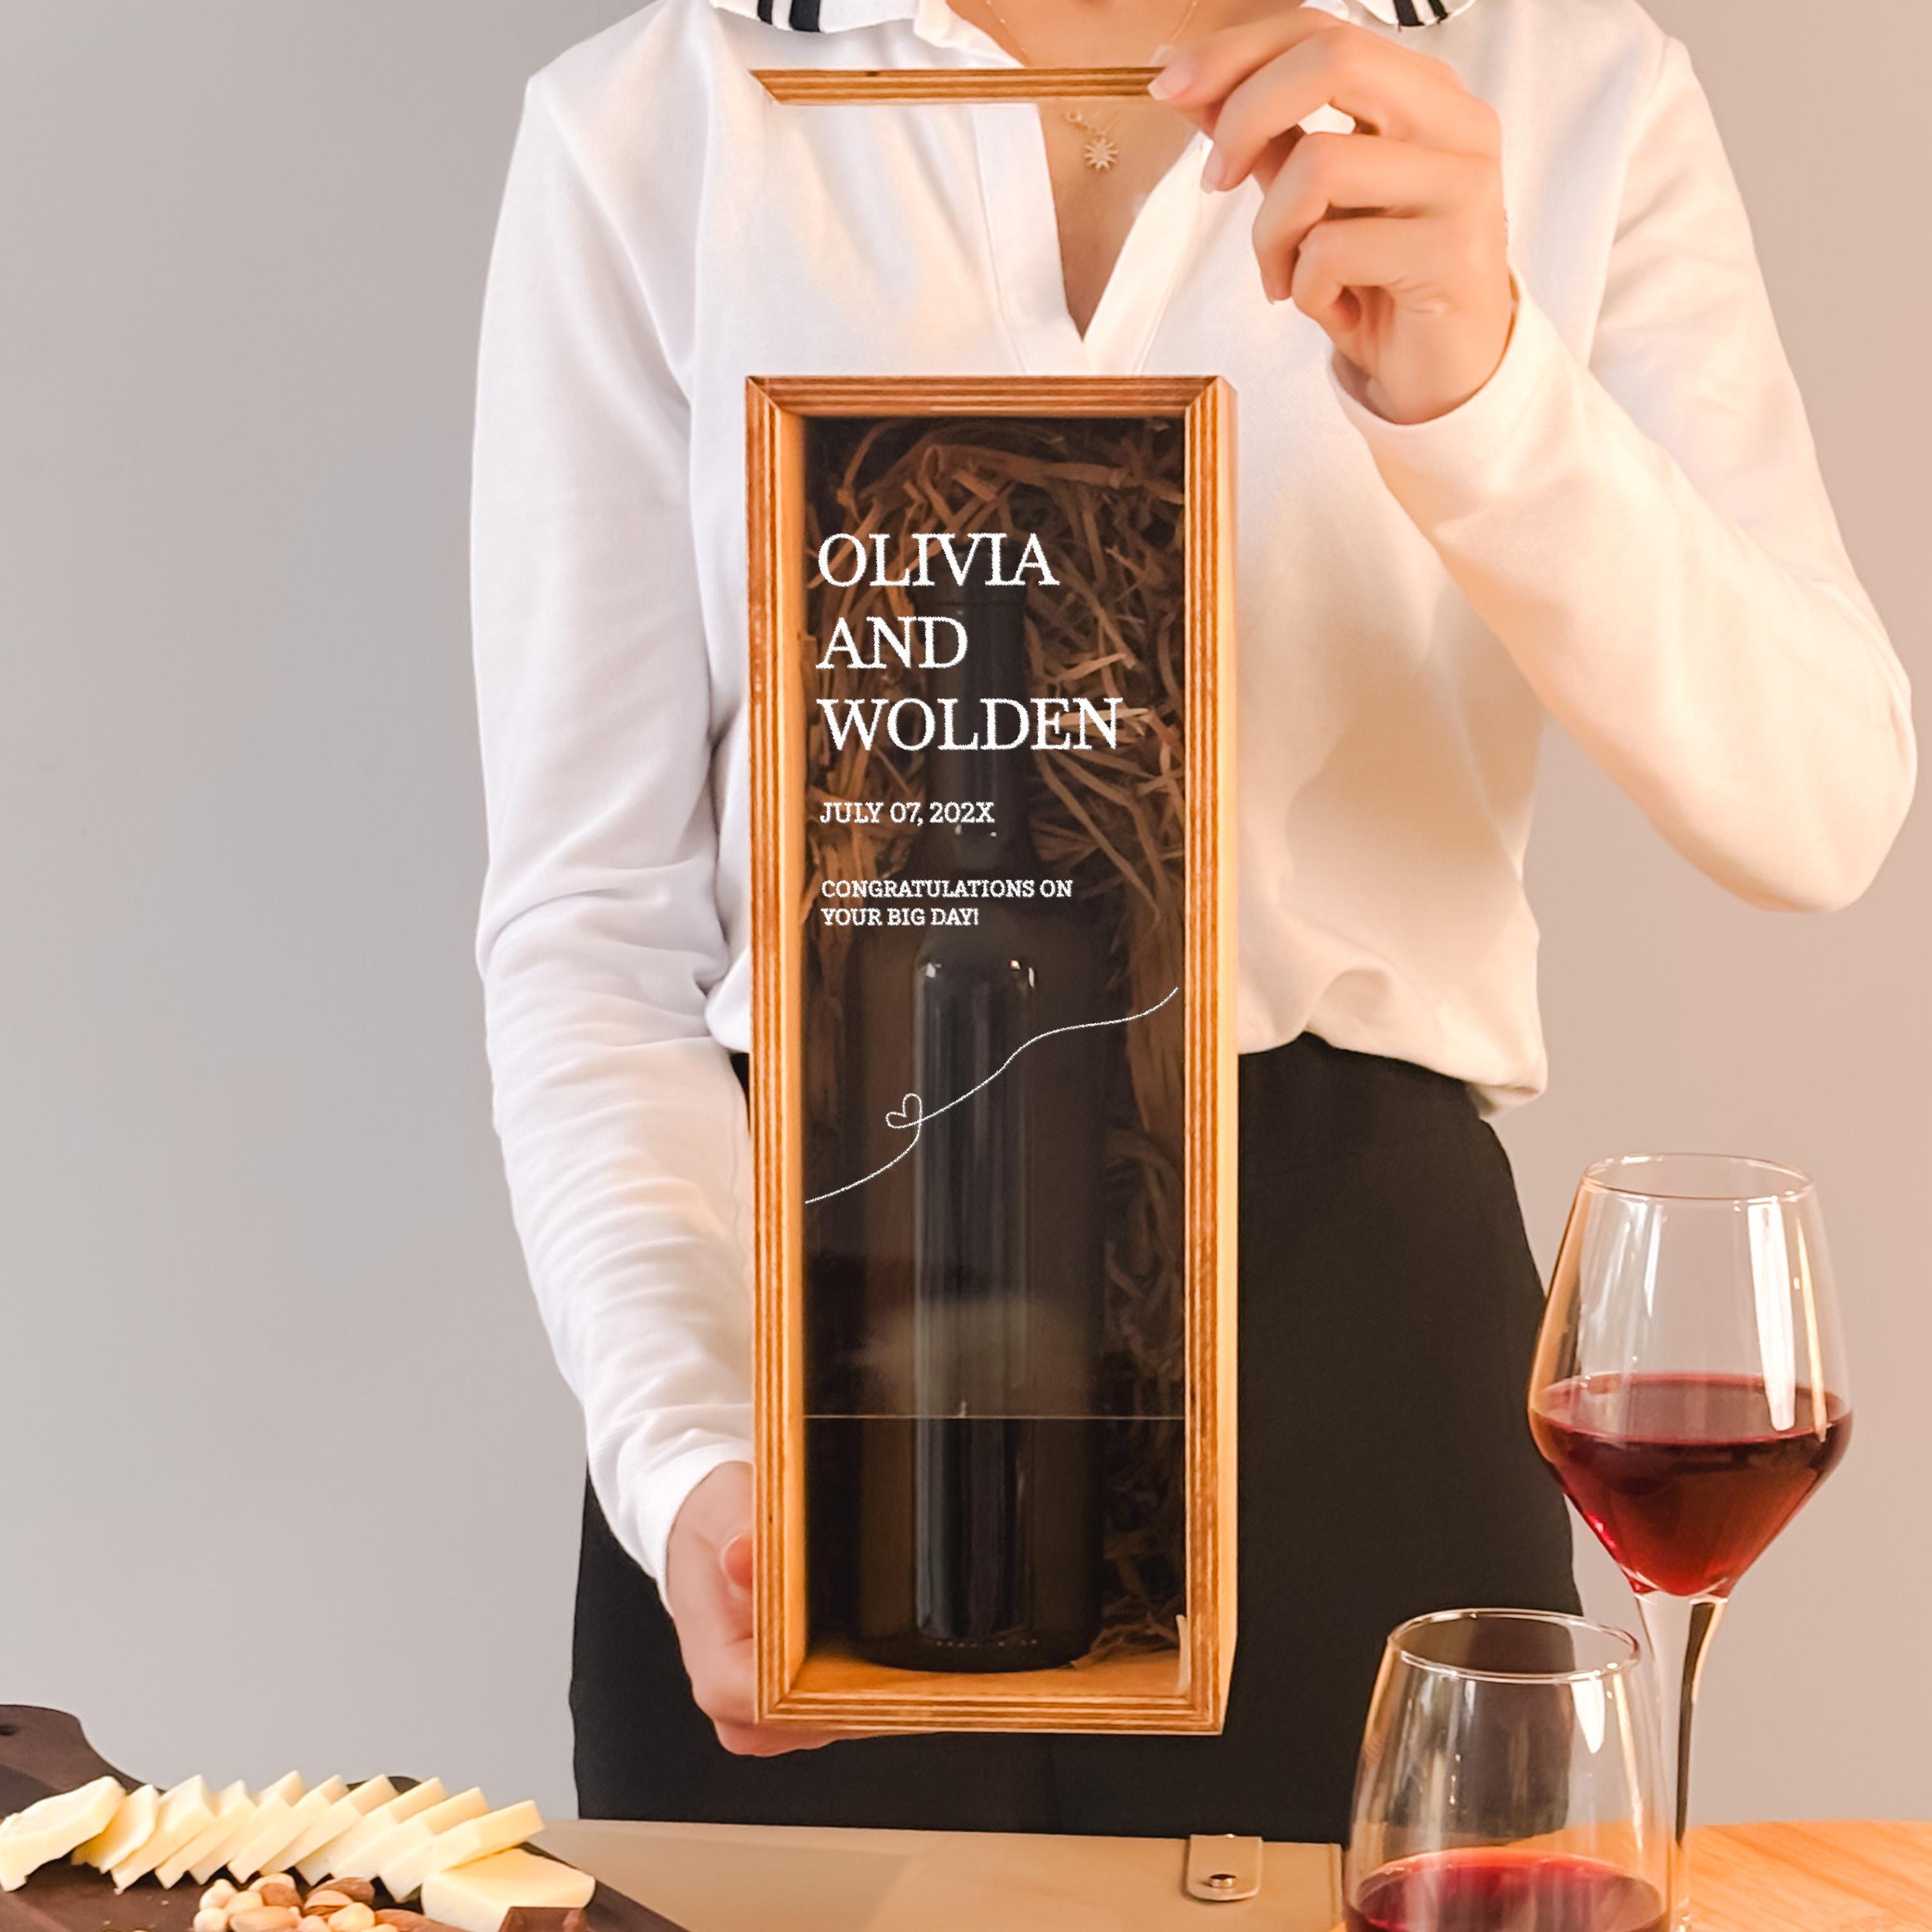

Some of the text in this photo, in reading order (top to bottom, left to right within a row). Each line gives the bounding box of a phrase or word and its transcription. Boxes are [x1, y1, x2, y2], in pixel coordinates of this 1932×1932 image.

[819, 533, 1060, 587] OLIVIA
[816, 616, 967, 668] AND
[816, 697, 1122, 751] WOLDEN
[820, 802, 994, 826] JULY 07, 202X
[822, 880, 1073, 897] CONGRATULATIONS ON
[820, 908, 978, 925] YOUR BIG DAY!
